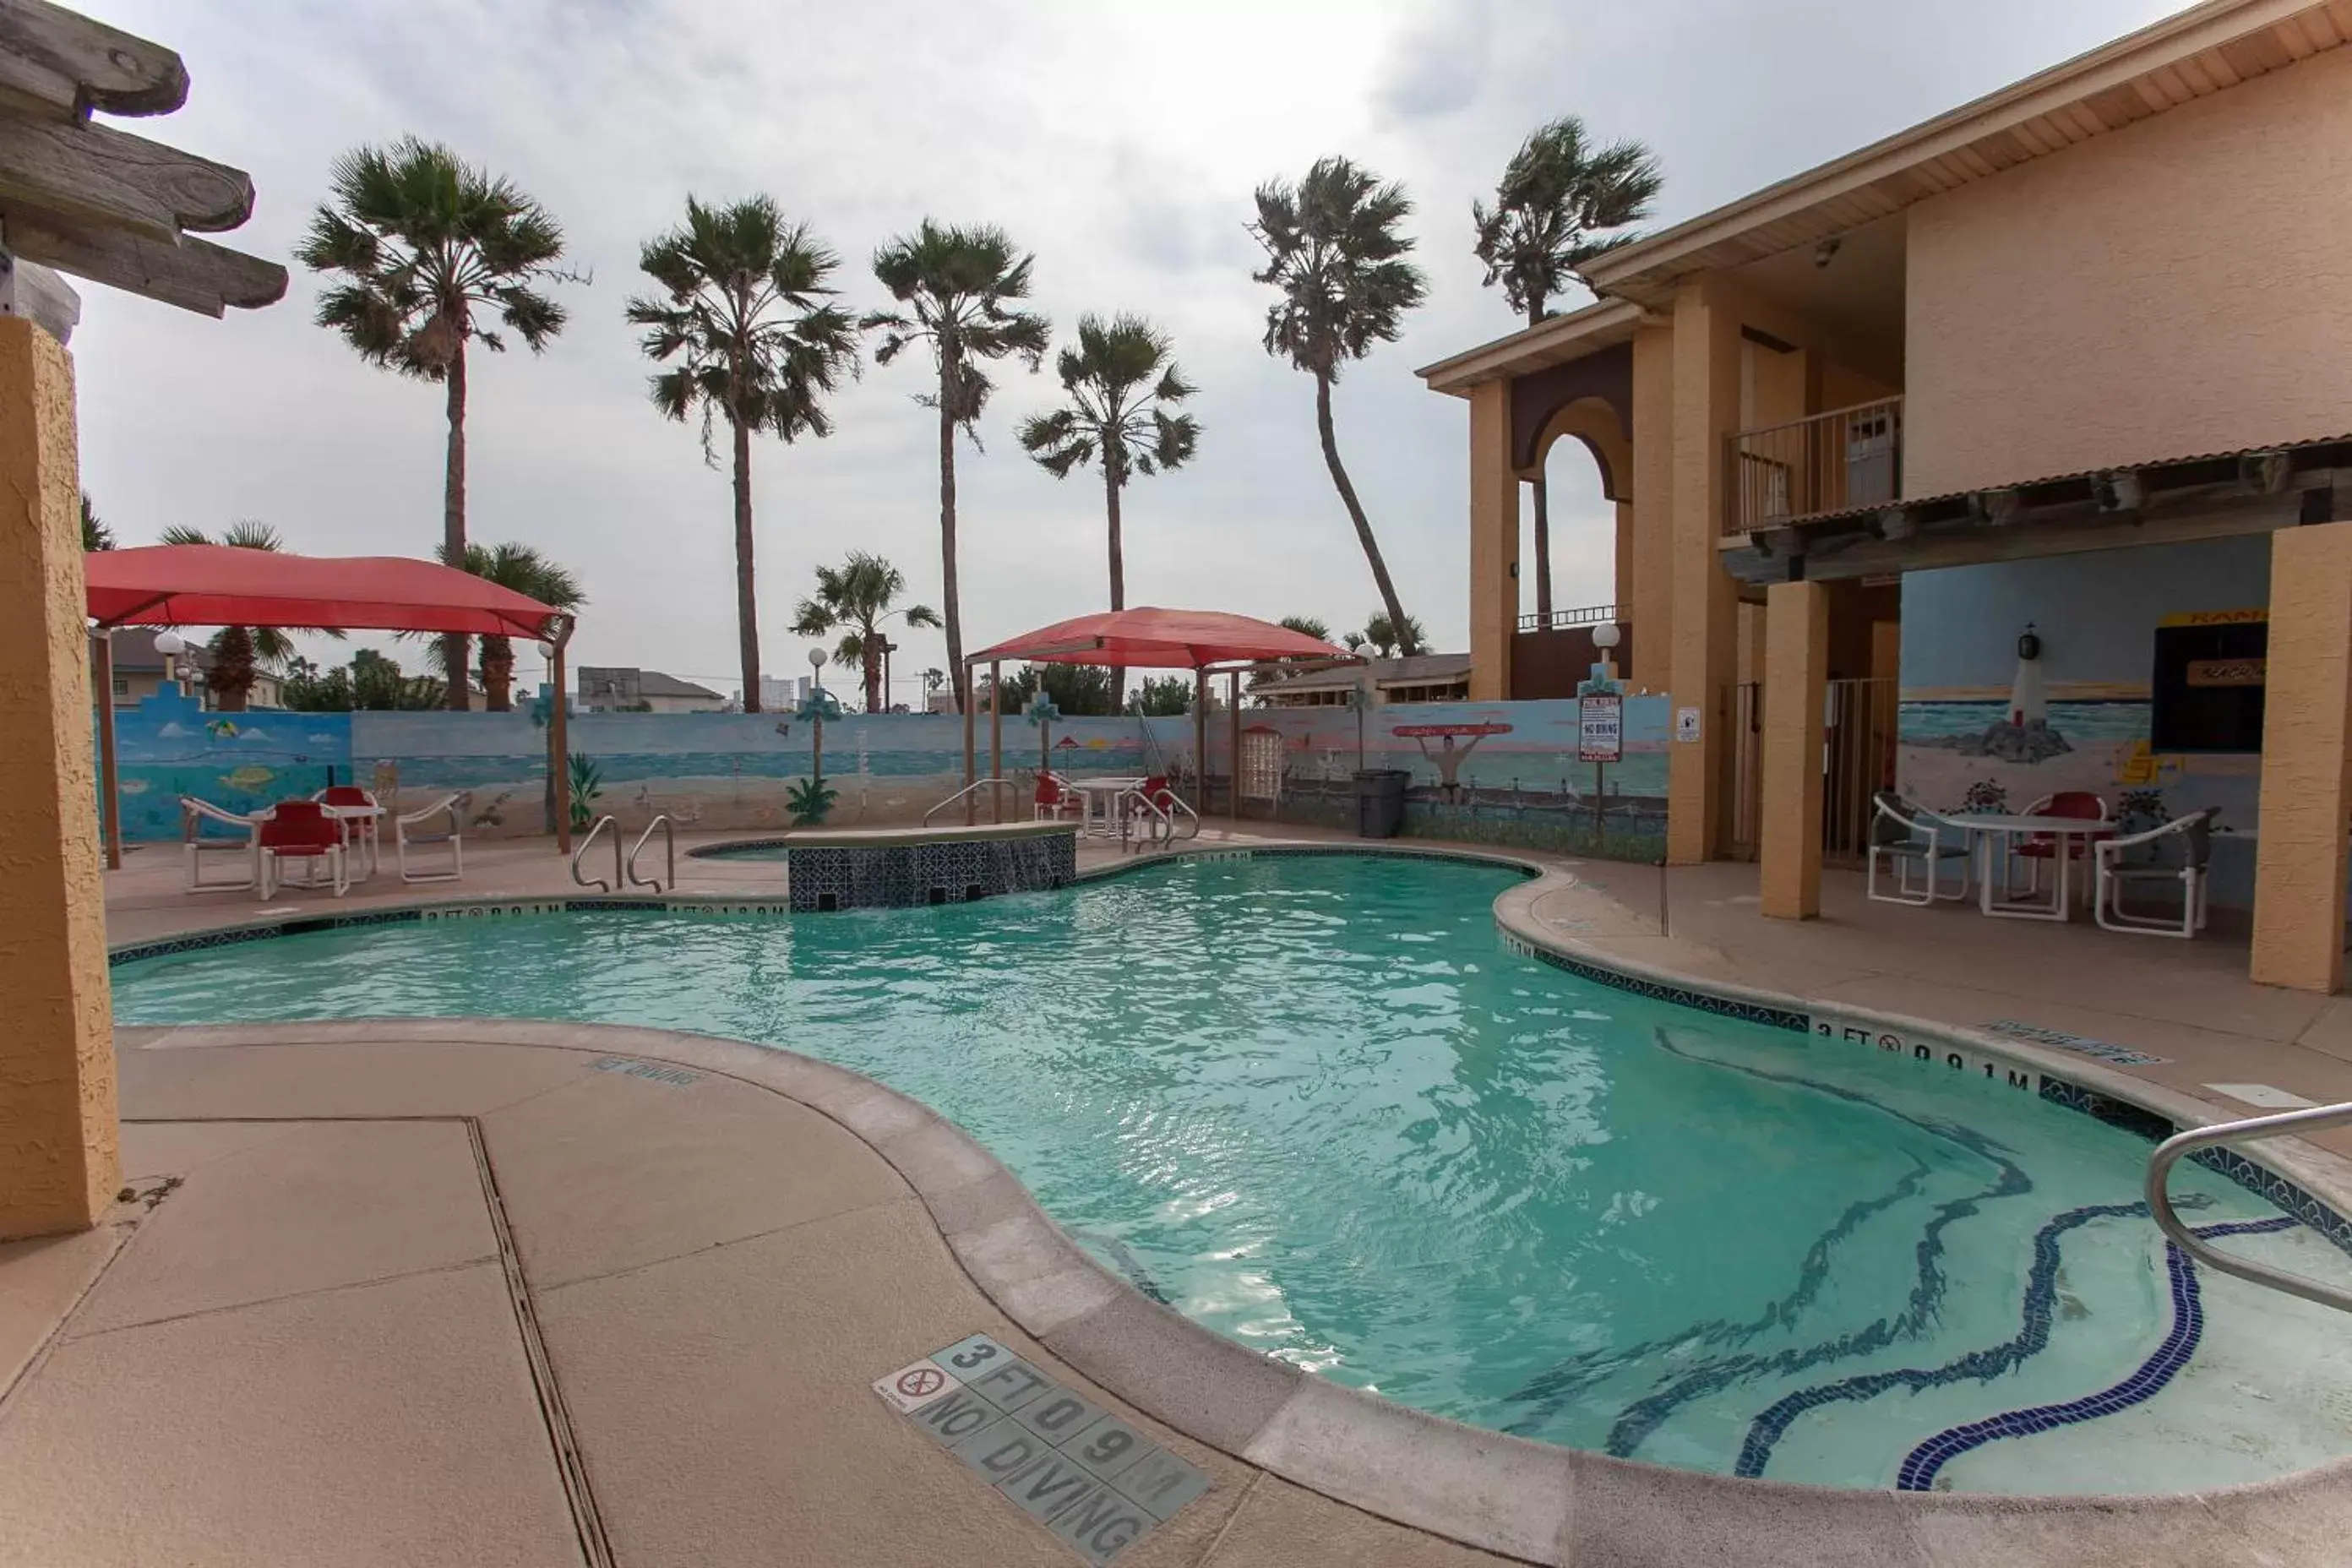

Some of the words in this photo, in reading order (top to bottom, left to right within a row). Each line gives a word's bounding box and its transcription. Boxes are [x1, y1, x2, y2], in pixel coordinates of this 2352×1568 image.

[951, 1343, 997, 1369] 3
[921, 1390, 987, 1436] NO
[981, 1438, 1142, 1558] DIVING
